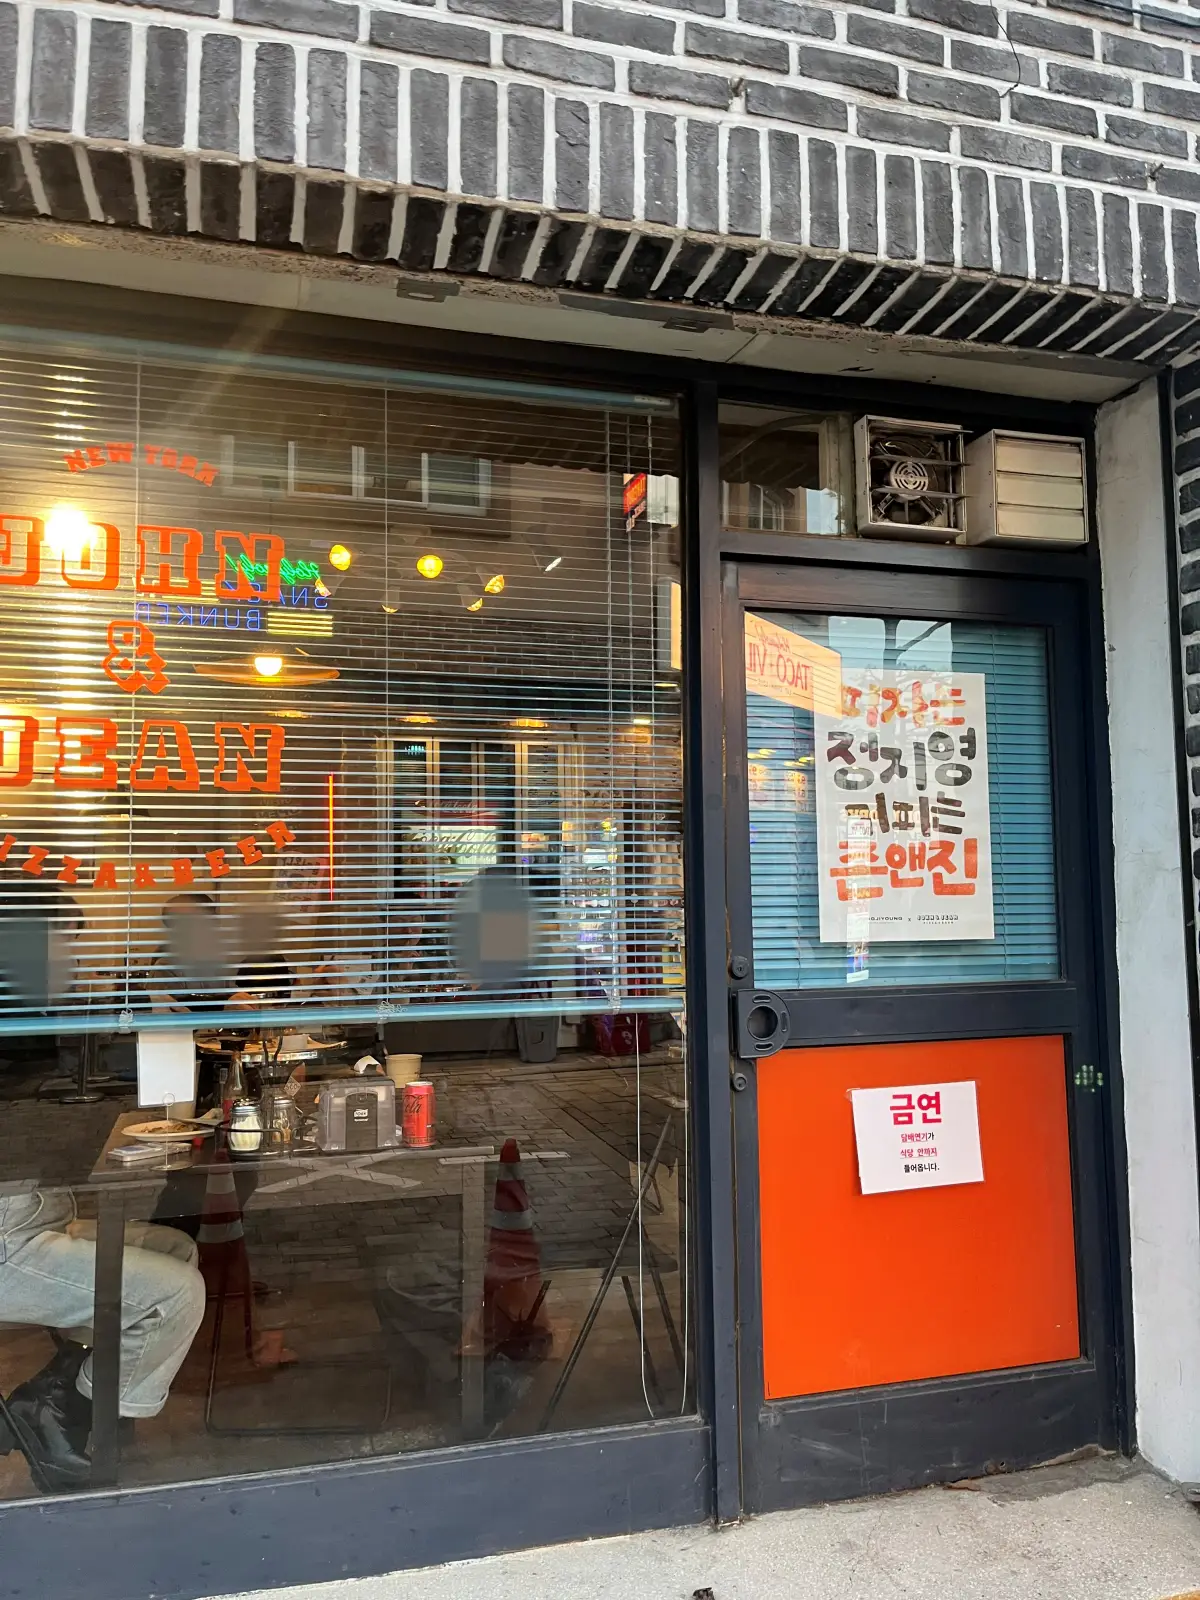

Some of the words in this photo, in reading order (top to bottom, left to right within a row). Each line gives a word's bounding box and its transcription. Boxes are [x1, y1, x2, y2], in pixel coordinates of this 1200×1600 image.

[63, 442, 135, 473] NEW
[144, 444, 220, 487] YORK
[841, 680, 967, 728] 피자는
[826, 726, 978, 791] 정지영
[844, 790, 967, 838] 커피는
[171, 820, 297, 886] BEER
[829, 837, 979, 902] 존앤진
[889, 1091, 942, 1125] 금연
[900, 1132, 935, 1143] 담배연기가
[900, 1148, 914, 1158] 식당
[903, 1162, 940, 1174] 들어옵니다.
